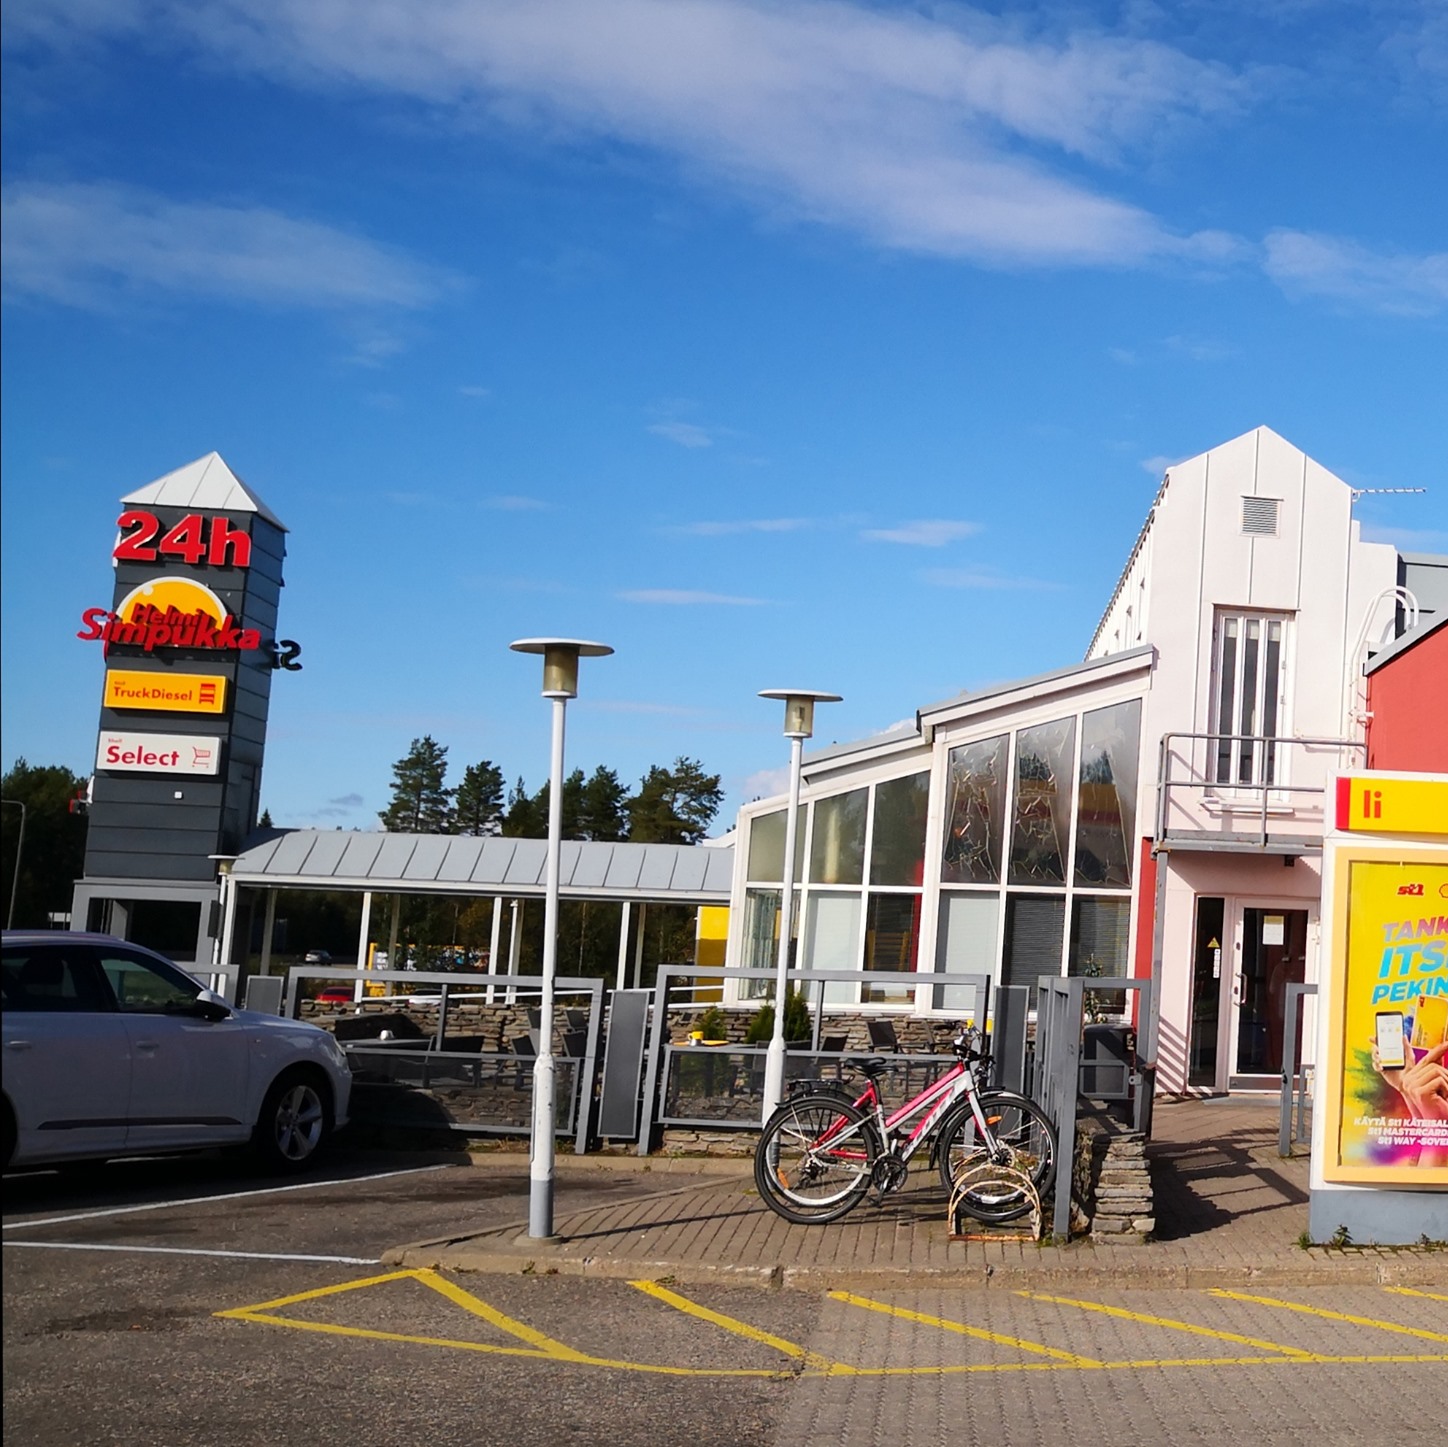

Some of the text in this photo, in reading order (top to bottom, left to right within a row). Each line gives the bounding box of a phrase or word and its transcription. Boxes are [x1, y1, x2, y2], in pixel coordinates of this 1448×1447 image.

[112, 510, 252, 567] 24h
[131, 602, 204, 626] Helmi
[76, 607, 262, 652] Simpukka
[113, 686, 193, 701] TruckDiesel
[106, 745, 180, 766] Select
[1354, 1117, 1387, 1127] KÄYTÄ
[1393, 1136, 1416, 1146] WAY
